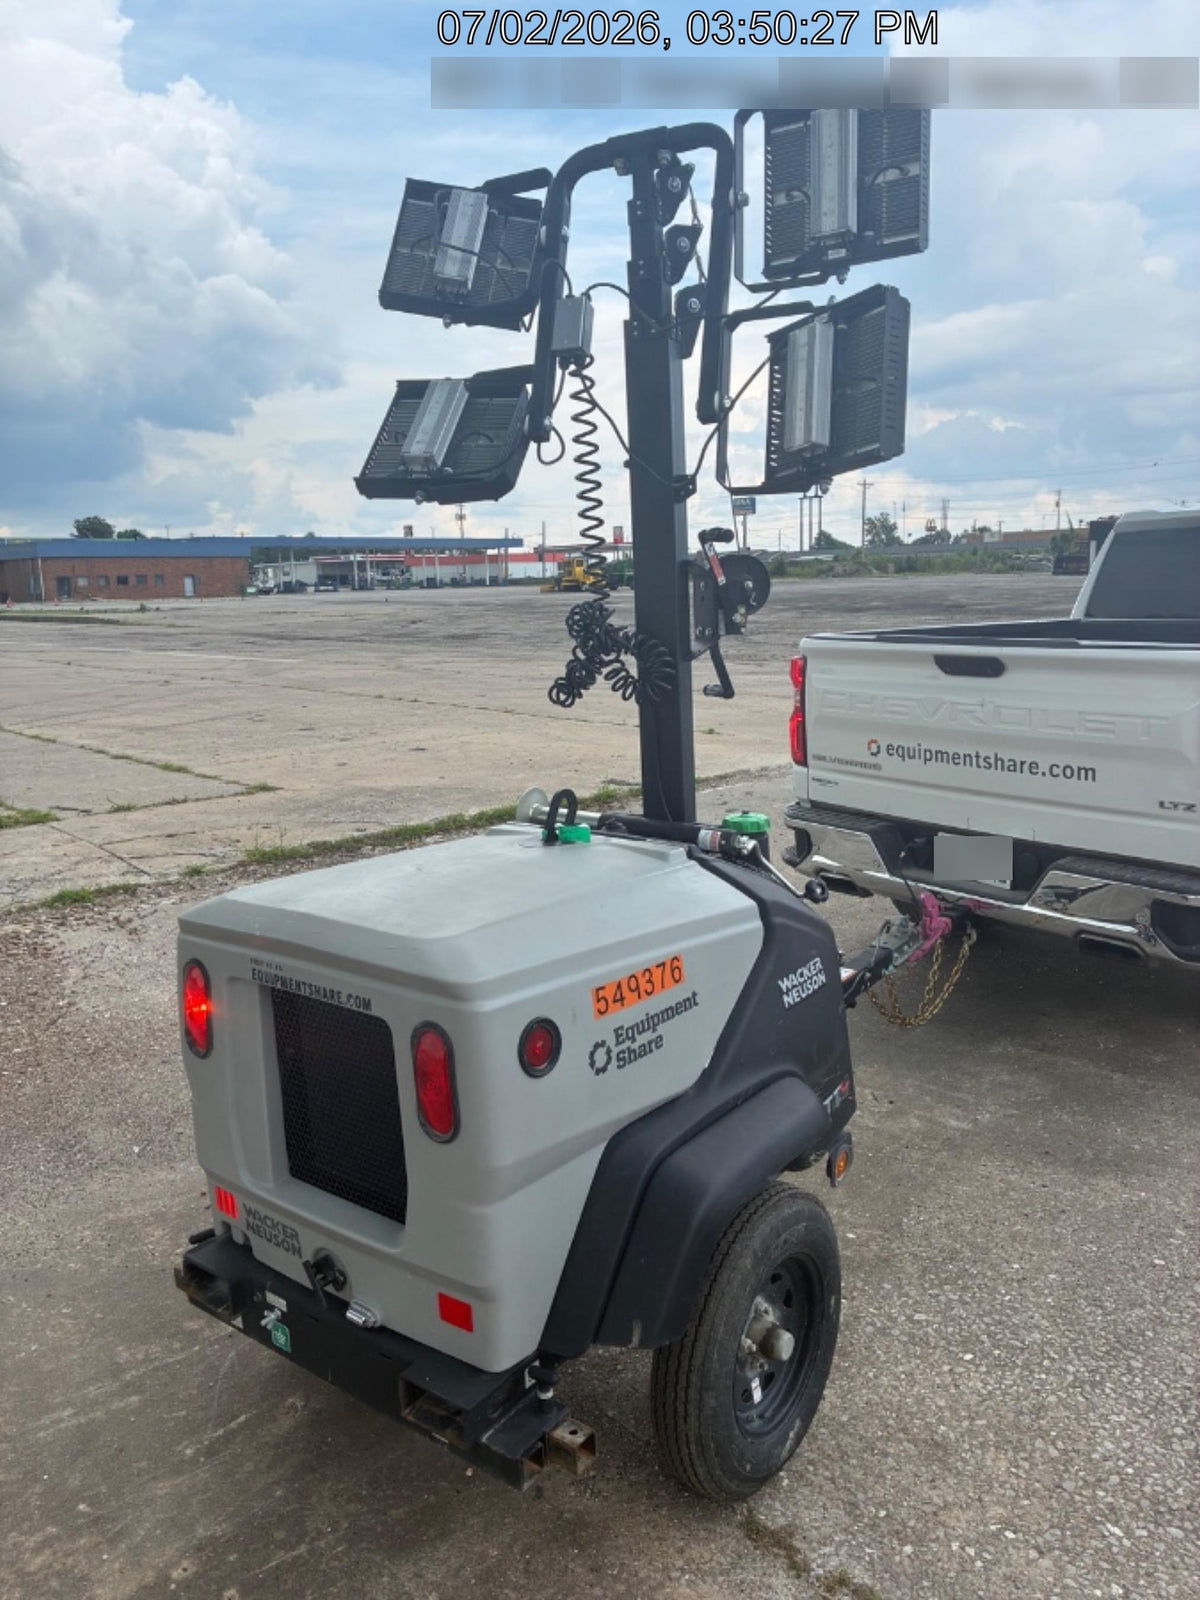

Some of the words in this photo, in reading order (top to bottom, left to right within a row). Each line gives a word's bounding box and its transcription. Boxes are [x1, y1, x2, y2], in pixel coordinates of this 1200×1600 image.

[820, 689, 1171, 741] CHEVROLET
[885, 740, 1097, 783] equipmentshare.com
[251, 968, 373, 1012] EQUIPMENTSHARE.COM
[594, 955, 683, 1017] 549376
[778, 957, 824, 993] WACKER
[782, 971, 826, 1009] NEUSON
[613, 990, 699, 1047] Equipment
[615, 1034, 664, 1071] Share
[242, 1202, 301, 1245] WACKER
[245, 1218, 303, 1259] NEUSON
